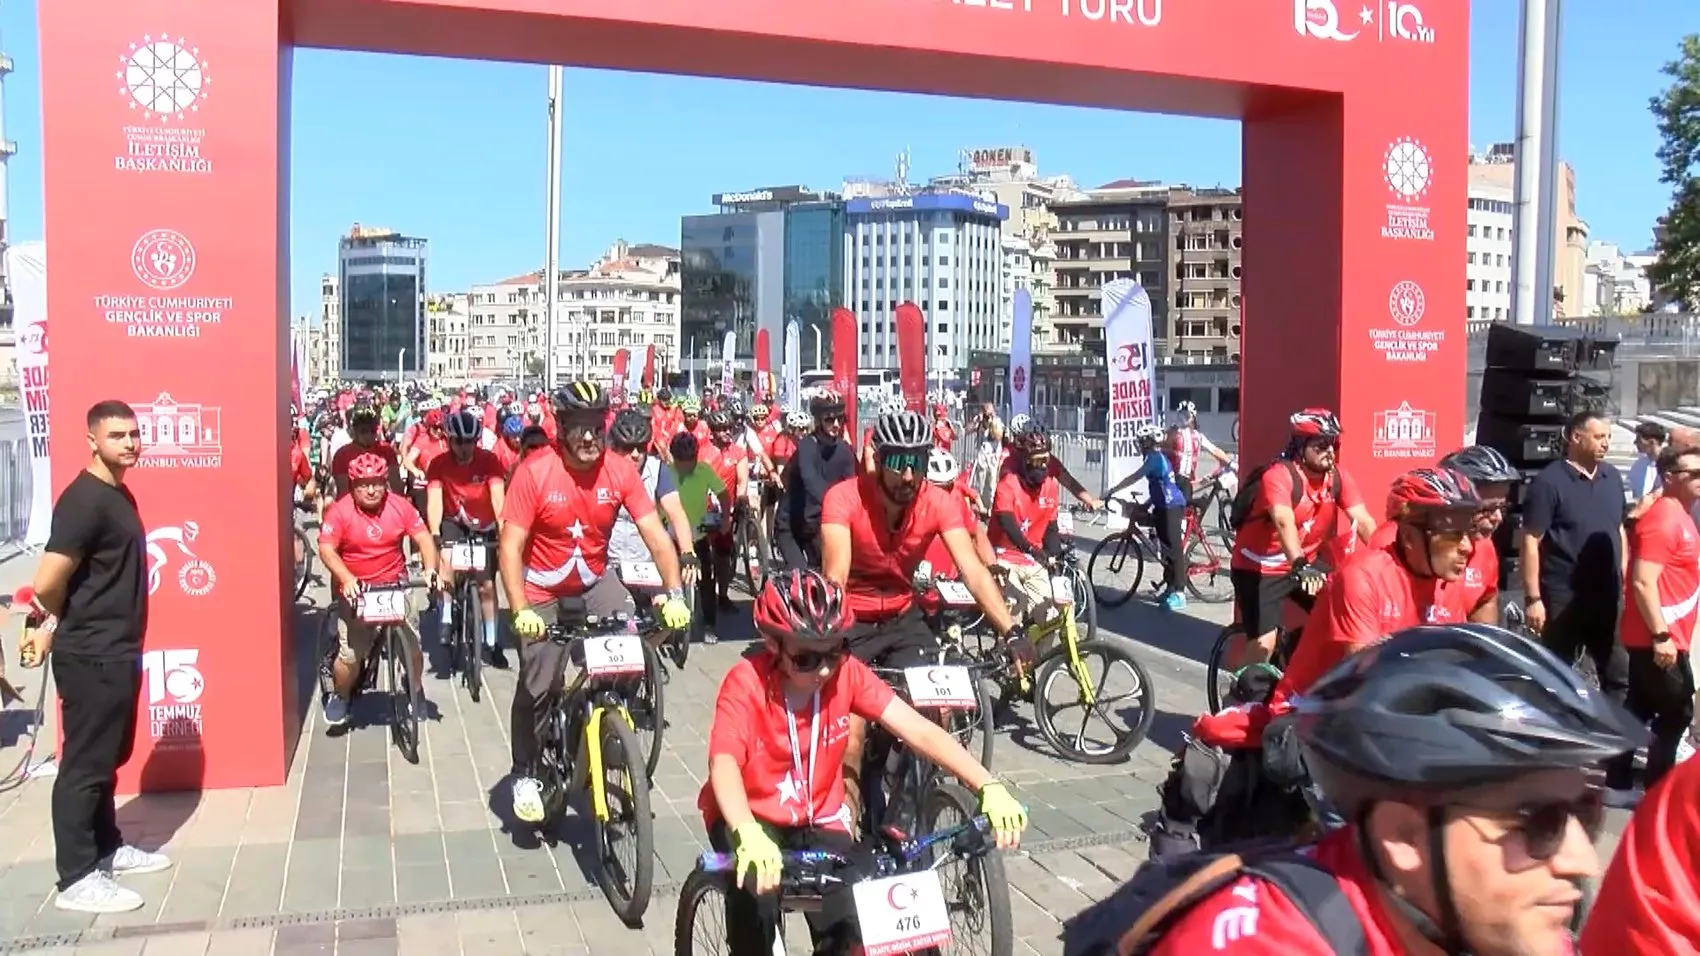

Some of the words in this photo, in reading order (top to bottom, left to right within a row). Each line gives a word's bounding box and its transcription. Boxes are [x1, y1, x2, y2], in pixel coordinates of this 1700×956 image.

[128, 140, 199, 160] İLETİŞİM
[115, 156, 212, 174] BAŞKANLIĞI
[1388, 216, 1428, 230] İLETİŞİM
[1381, 227, 1434, 241] BAŞKANLIĞI
[94, 294, 145, 309] TÜRKİYE
[149, 296, 233, 310] CUMHURİYETİ
[105, 309, 162, 326] GENÇLİK
[166, 312, 182, 324] VE
[186, 312, 221, 324] SPOR
[127, 324, 200, 338] BAKANLIĞI
[1369, 328, 1397, 340] TÜRKİYE
[1398, 330, 1445, 342] CUMHURİYETİ
[1374, 340, 1404, 353] GENÇLİK
[1407, 341, 1417, 351] VE
[1419, 342, 1438, 352] SPOR
[1386, 350, 1427, 362] BAKANLIĞI
[181, 454, 221, 468] VALİLİĞİ
[143, 648, 204, 703] 15
[935, 687, 951, 696] 101
[149, 704, 202, 720] TEMMUZ
[151, 718, 203, 737] DERNEĞİ
[896, 914, 921, 932] 476
